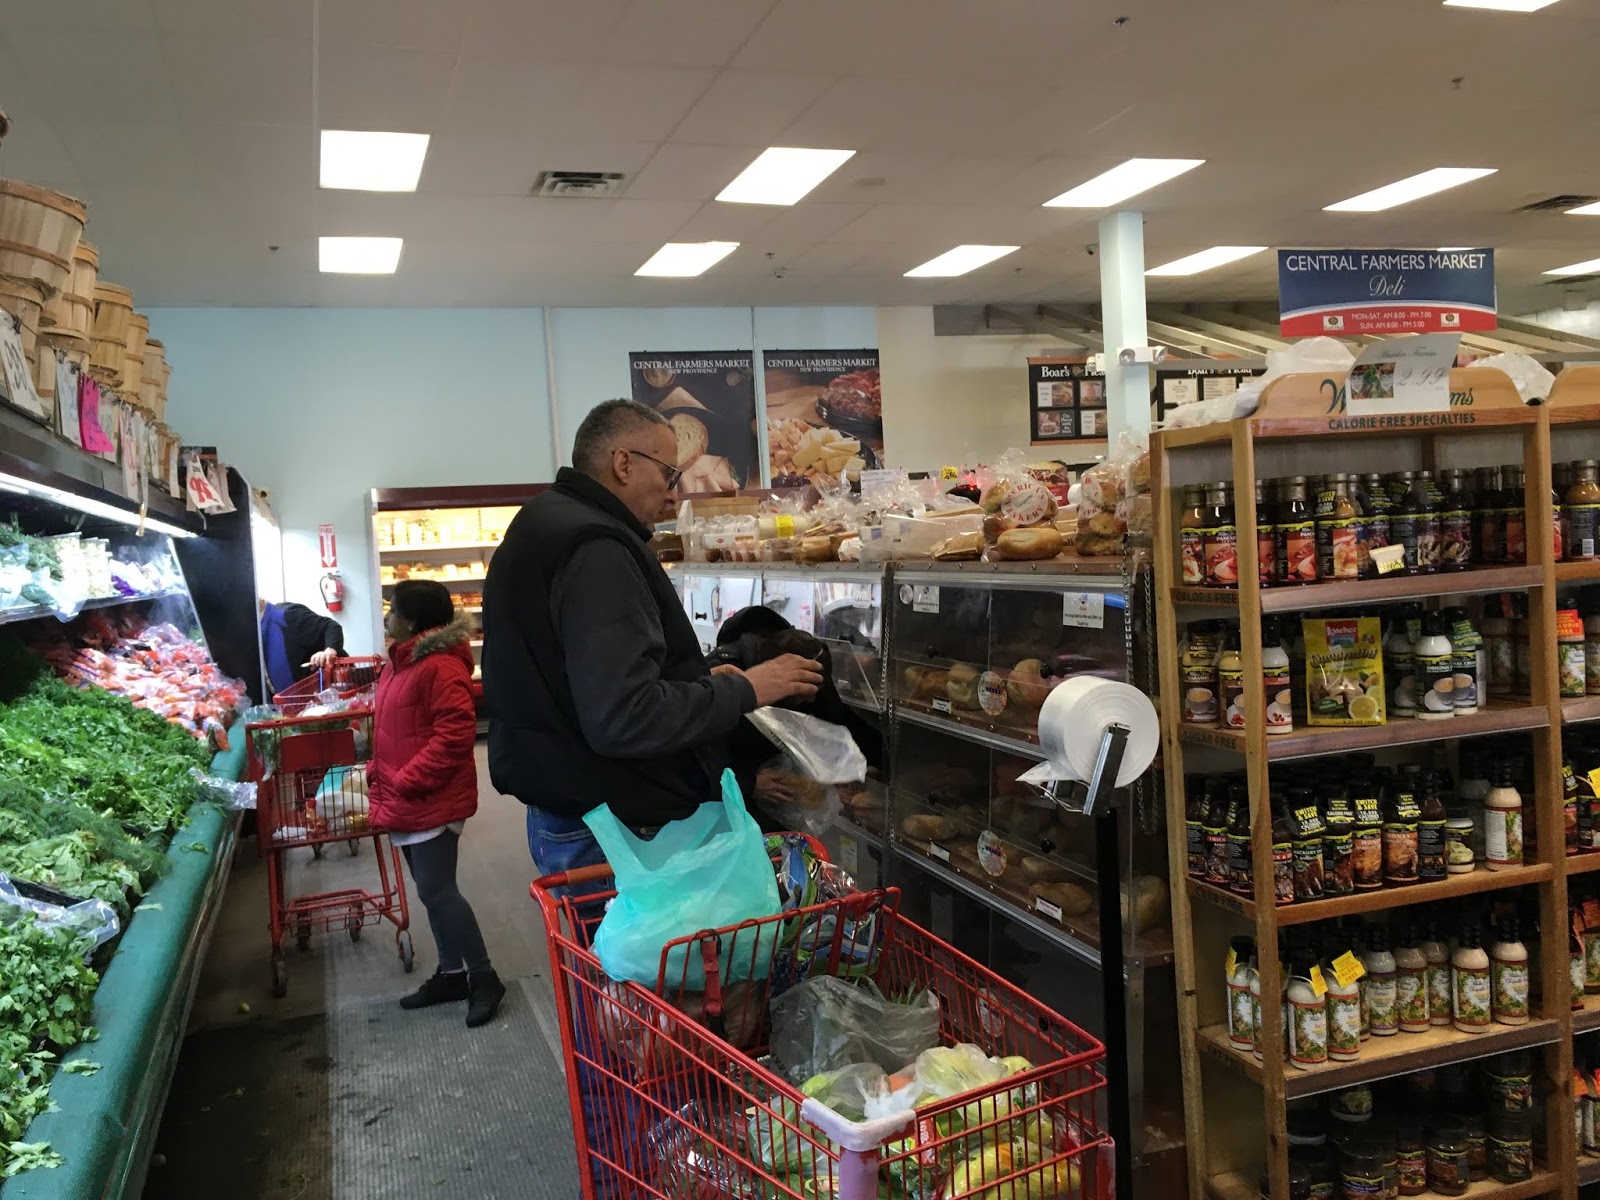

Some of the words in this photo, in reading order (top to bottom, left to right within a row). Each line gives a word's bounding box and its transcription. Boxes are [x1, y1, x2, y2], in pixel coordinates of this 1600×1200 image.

[1286, 255, 1357, 271] CENTRAL
[1361, 254, 1425, 270] FARMERS
[1429, 253, 1486, 270] MARKET
[1369, 274, 1406, 297] Deli
[1420, 311, 1432, 319] 7:00
[1375, 321, 1386, 329] AM
[1386, 321, 1399, 329] 8:00
[1402, 321, 1413, 329] PM
[1413, 320, 1425, 328] 5:00
[634, 360, 674, 369] CENTRAL
[675, 360, 714, 369] FARMERS
[714, 359, 751, 368] MARKET
[767, 359, 805, 367] CENTRAL
[806, 358, 842, 367] FARMERS
[843, 358, 877, 366] MARKET
[1041, 365, 1070, 378] Boar's
[1328, 419, 1377, 431] CALORIE
[1379, 416, 1406, 428] FREE
[1409, 413, 1476, 426] SPECIALTIES
[1215, 592, 1238, 604] FREE
[1294, 805, 1318, 817] SWITCH
[1303, 811, 1319, 820] SAVE
